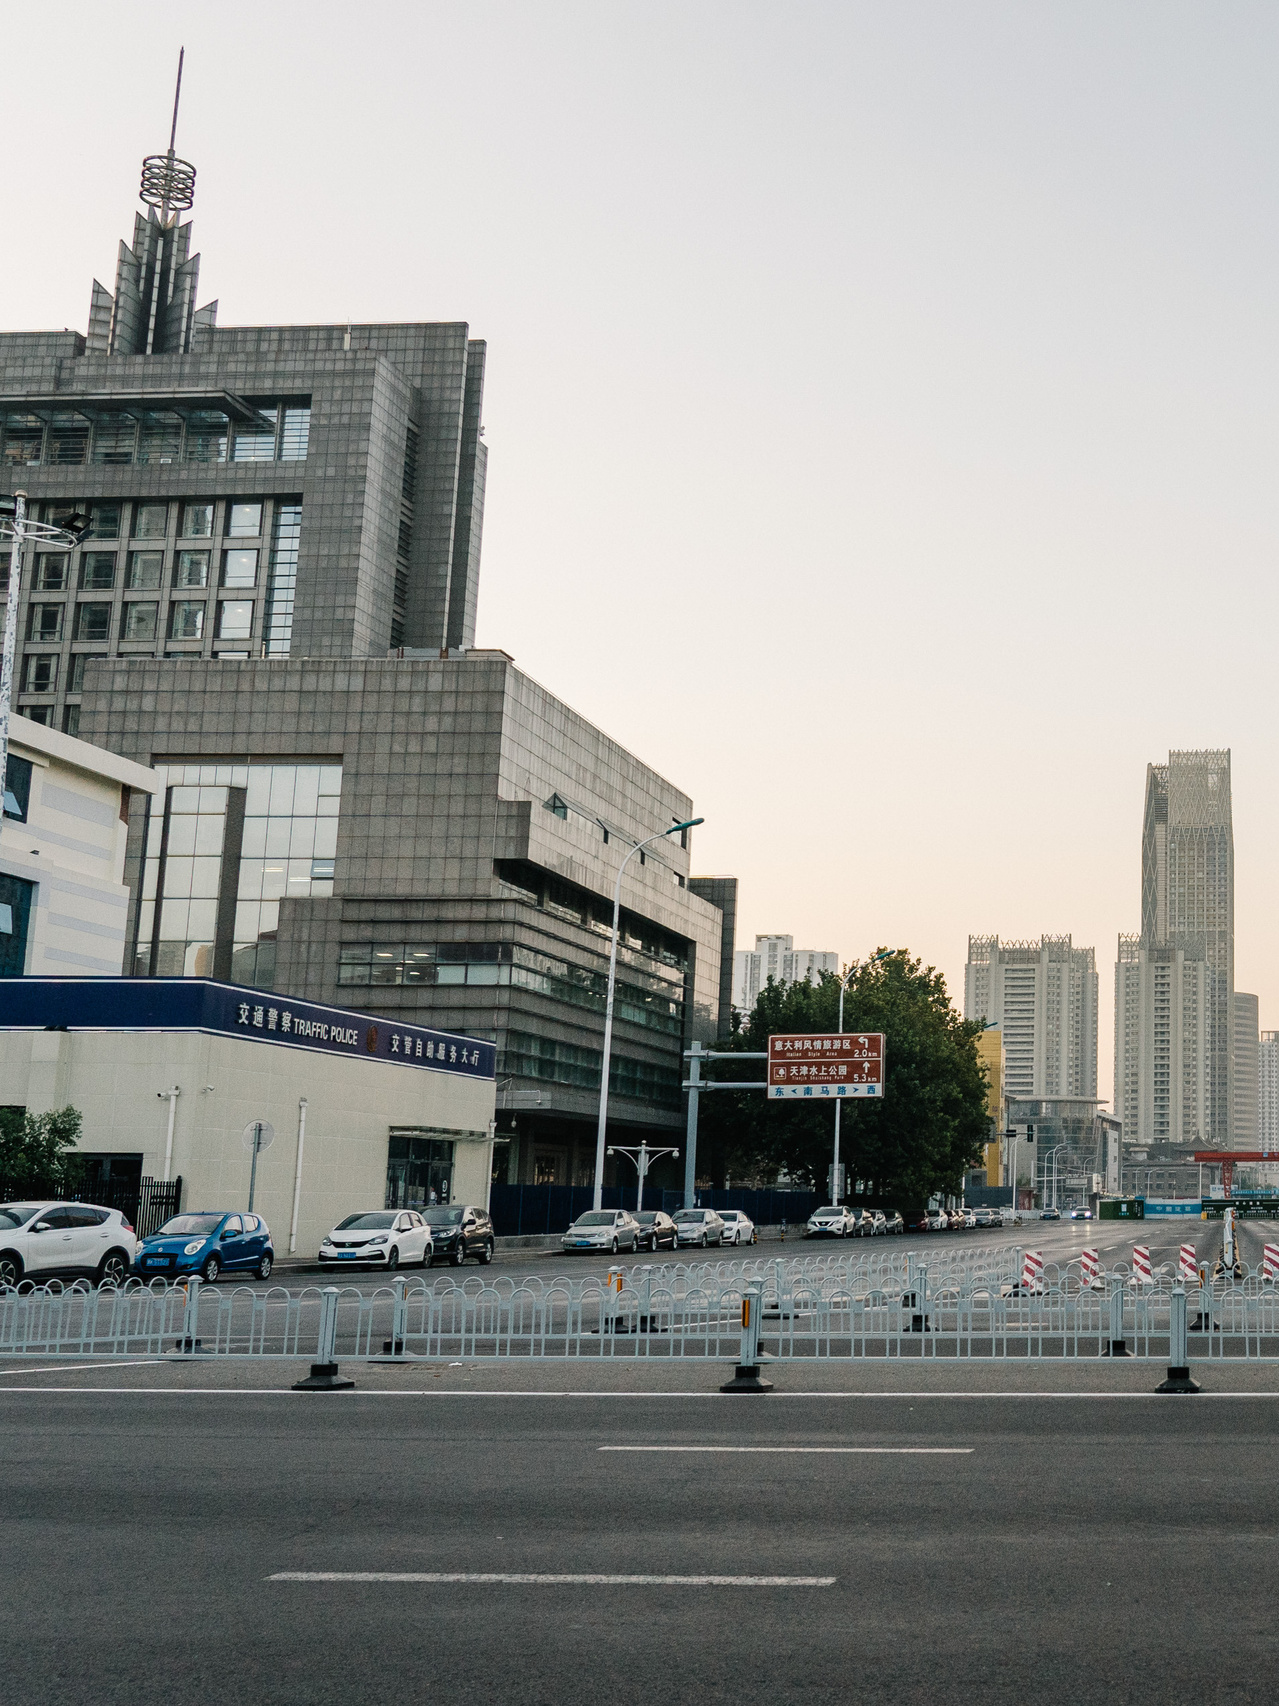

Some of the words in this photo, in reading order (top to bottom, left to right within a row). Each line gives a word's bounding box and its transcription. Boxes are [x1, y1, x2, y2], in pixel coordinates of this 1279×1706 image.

[238, 1003, 292, 1032] 交通警察
[294, 1018, 329, 1041] TRAFFIC
[330, 1026, 358, 1046] POLICE
[391, 1034, 480, 1066] 交管自助服务大厅
[774, 1040, 851, 1050] 意大利风情旅游区
[790, 1065, 847, 1076] 天津水上公园
[775, 1087, 784, 1096] 东
[803, 1086, 847, 1096] 南马路
[867, 1085, 876, 1095] 西
